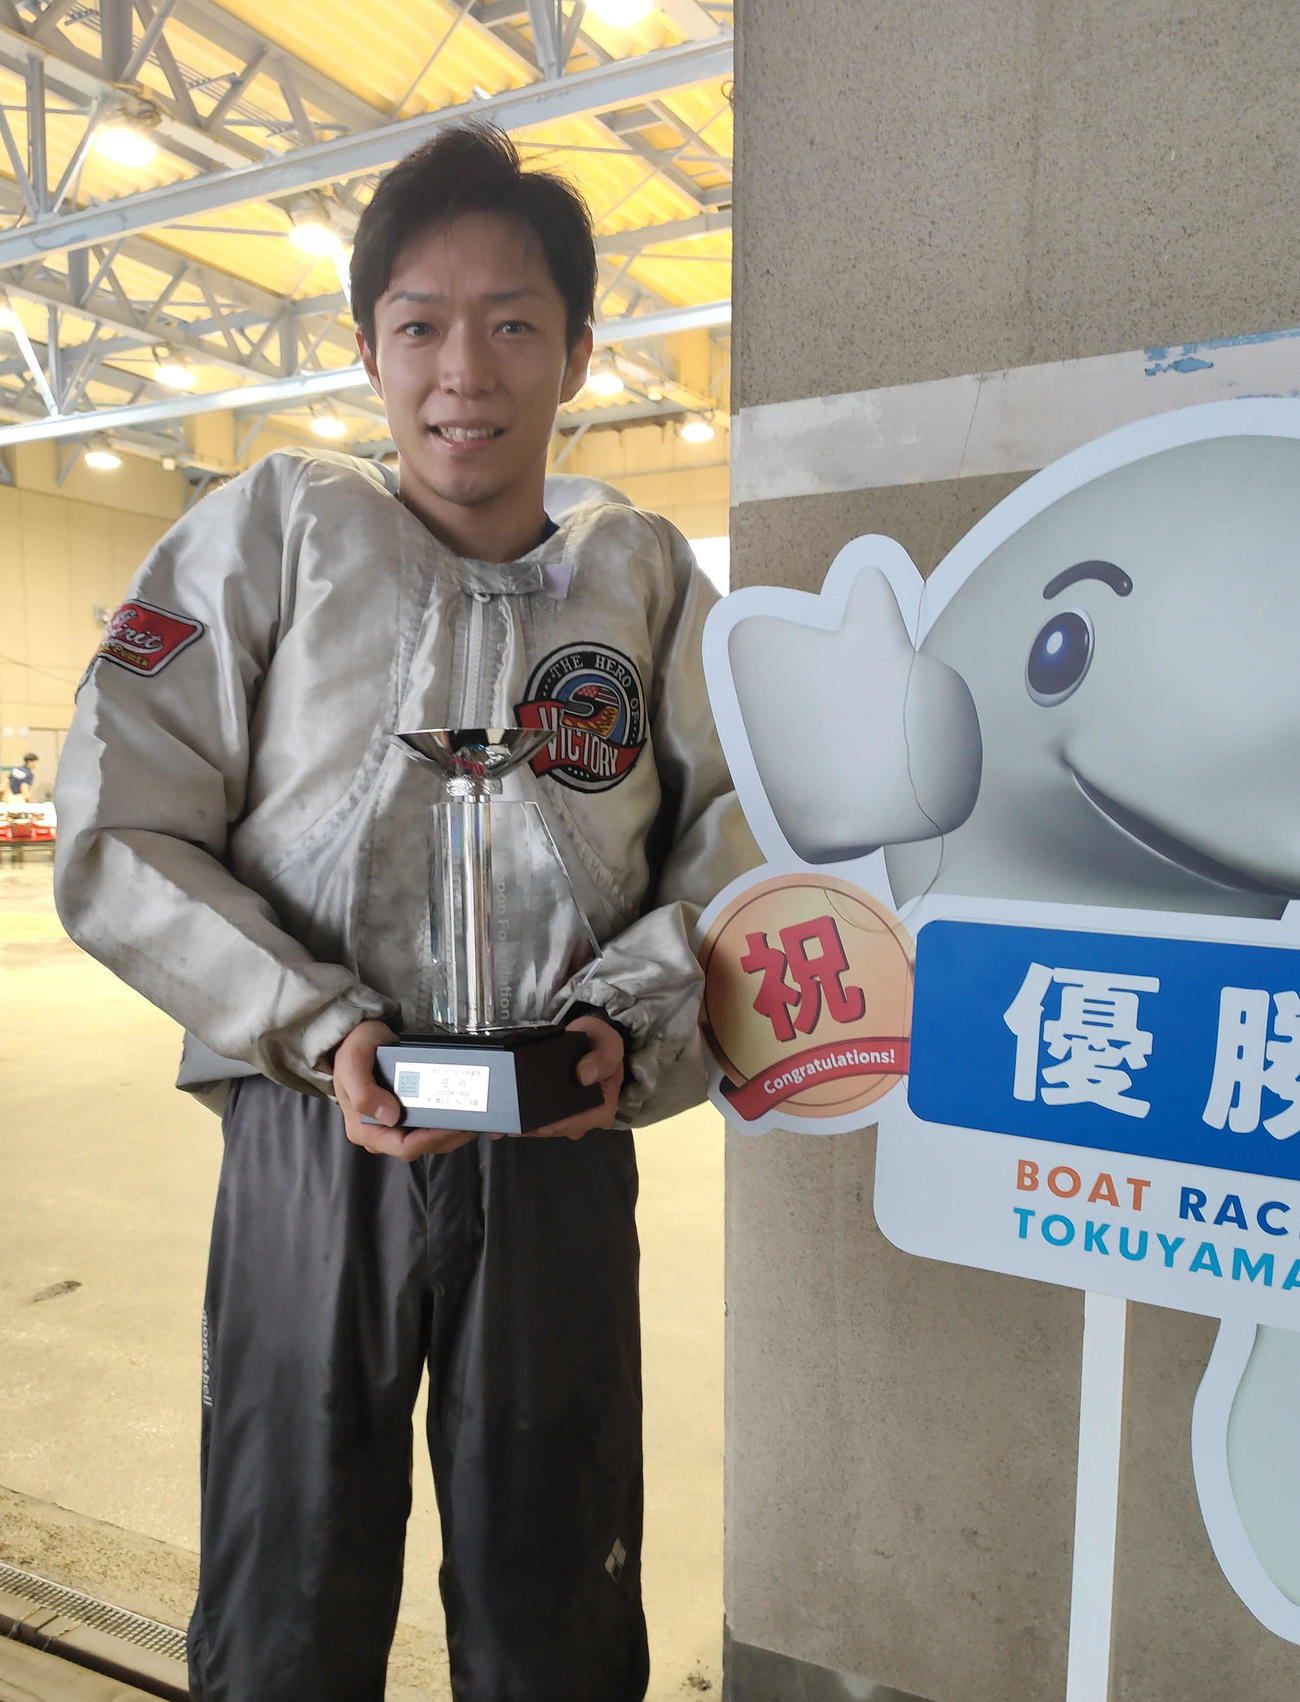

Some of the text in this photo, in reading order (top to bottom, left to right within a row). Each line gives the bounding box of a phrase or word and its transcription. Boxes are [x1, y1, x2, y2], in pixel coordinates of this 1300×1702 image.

[550, 654, 641, 718] THE HERO OF
[538, 706, 618, 777] VICTORY
[497, 919, 512, 1020] Fodation
[741, 915, 866, 1042] 祝
[763, 1049, 896, 1095] Congratulations!
[1016, 1159, 1300, 1240] BOAT RAC
